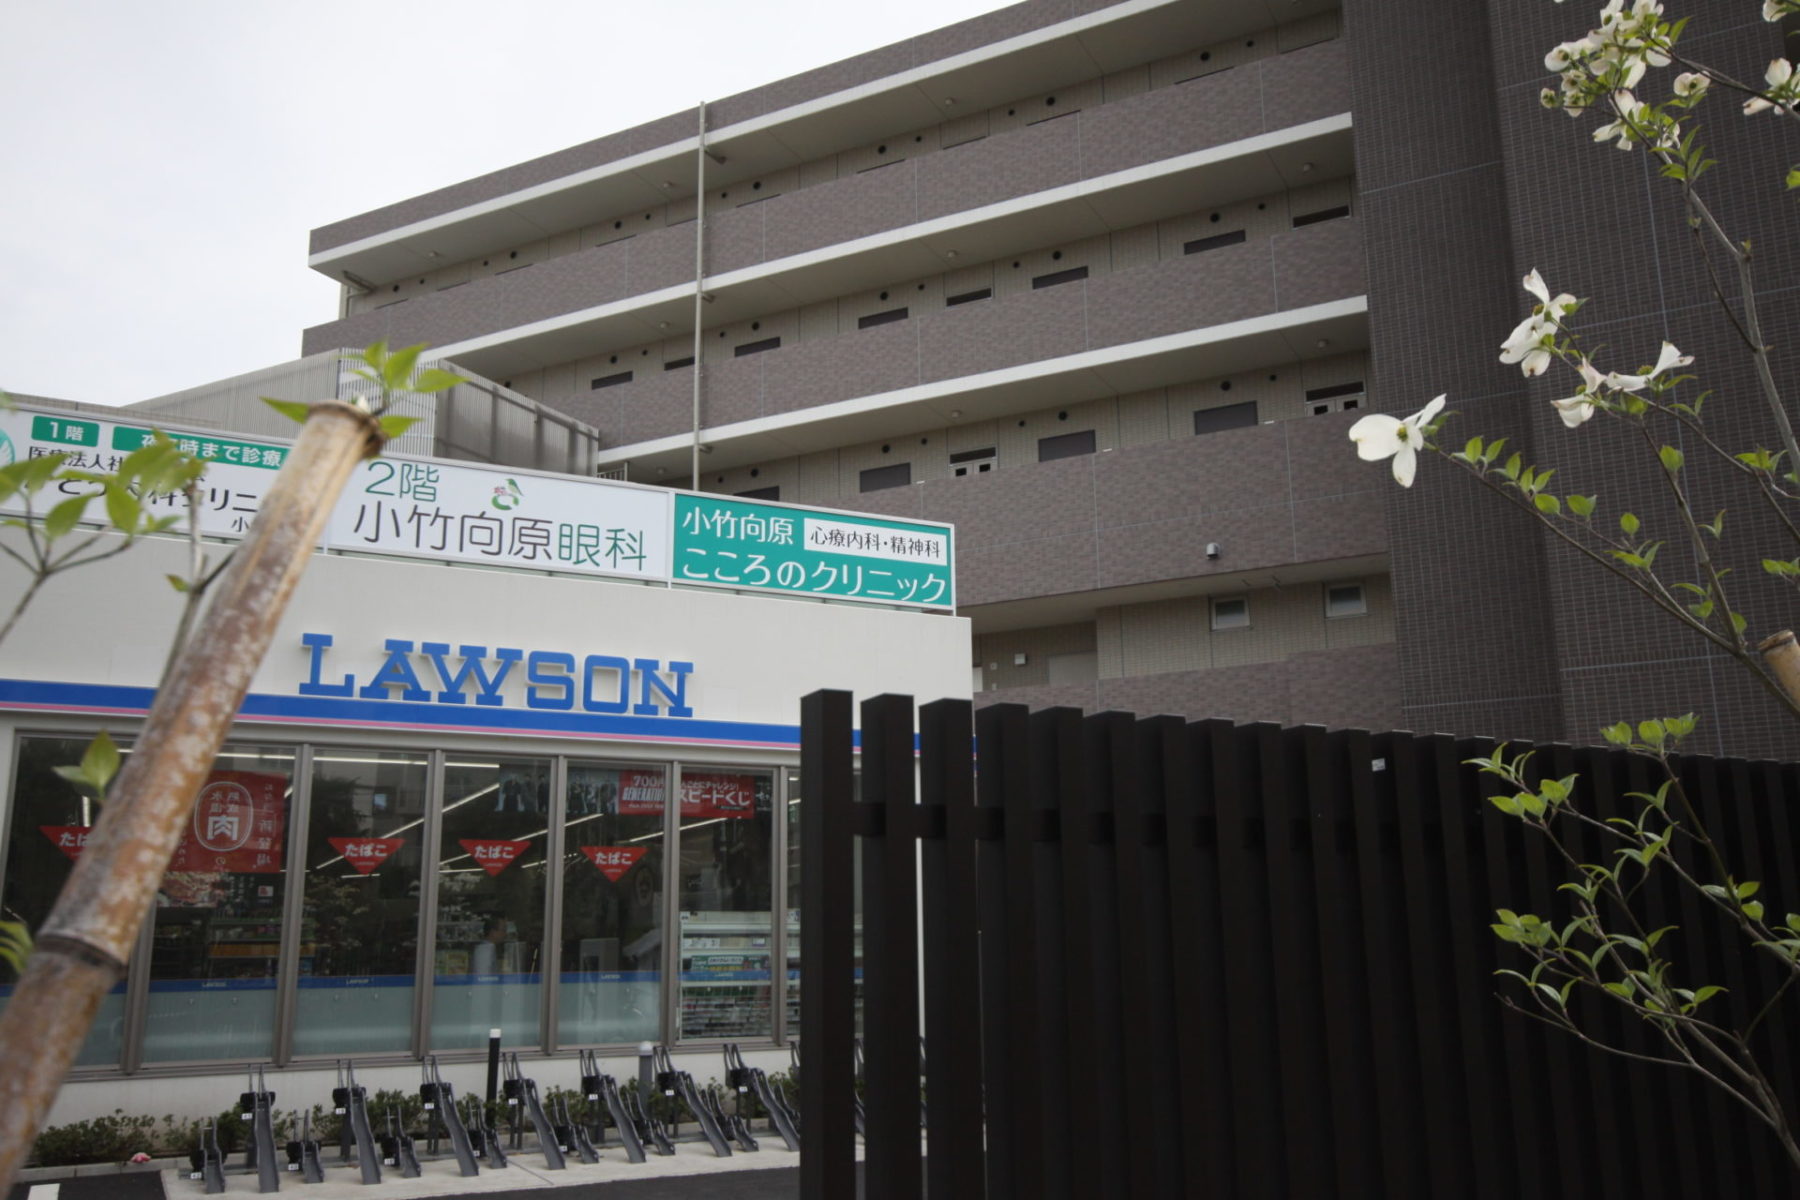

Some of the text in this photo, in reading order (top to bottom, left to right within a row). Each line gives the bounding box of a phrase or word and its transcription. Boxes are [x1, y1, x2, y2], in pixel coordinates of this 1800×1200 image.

[50, 422, 83, 442] 1階
[29, 446, 123, 472] 医法人社
[141, 433, 282, 467] 夜時まで診療
[365, 461, 440, 503] 2階
[353, 500, 647, 571] 小竹向原眼科
[682, 506, 795, 545] 小竹向原
[810, 526, 941, 559] 心療内科・精神科
[682, 547, 946, 603] こころのクリニック
[299, 632, 694, 718] LAWSON
[344, 843, 388, 857] たばこ
[474, 845, 515, 859] たばこ
[595, 851, 632, 866] たばこ
